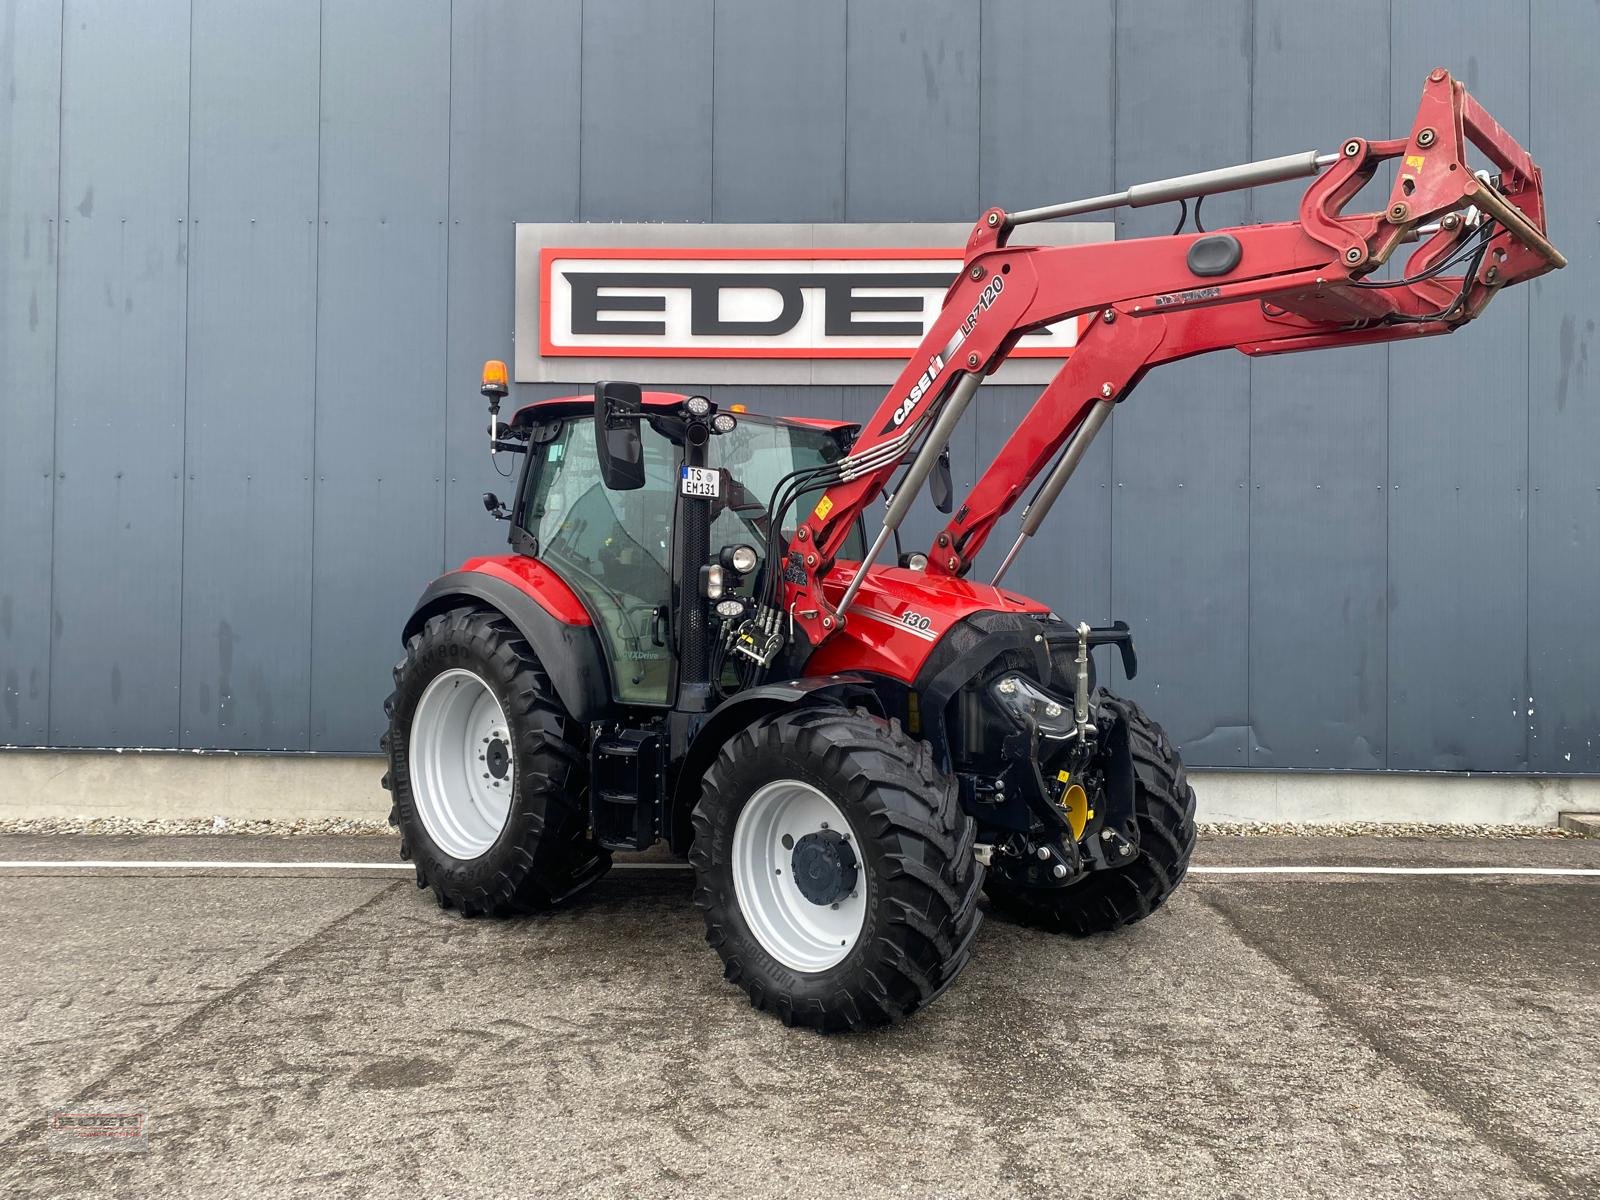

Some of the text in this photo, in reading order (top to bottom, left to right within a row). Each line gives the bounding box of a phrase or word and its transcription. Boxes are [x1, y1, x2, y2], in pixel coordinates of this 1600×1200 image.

[561, 272, 1053, 336] EDE
[690, 469, 702, 481] TS
[901, 610, 931, 631] 130
